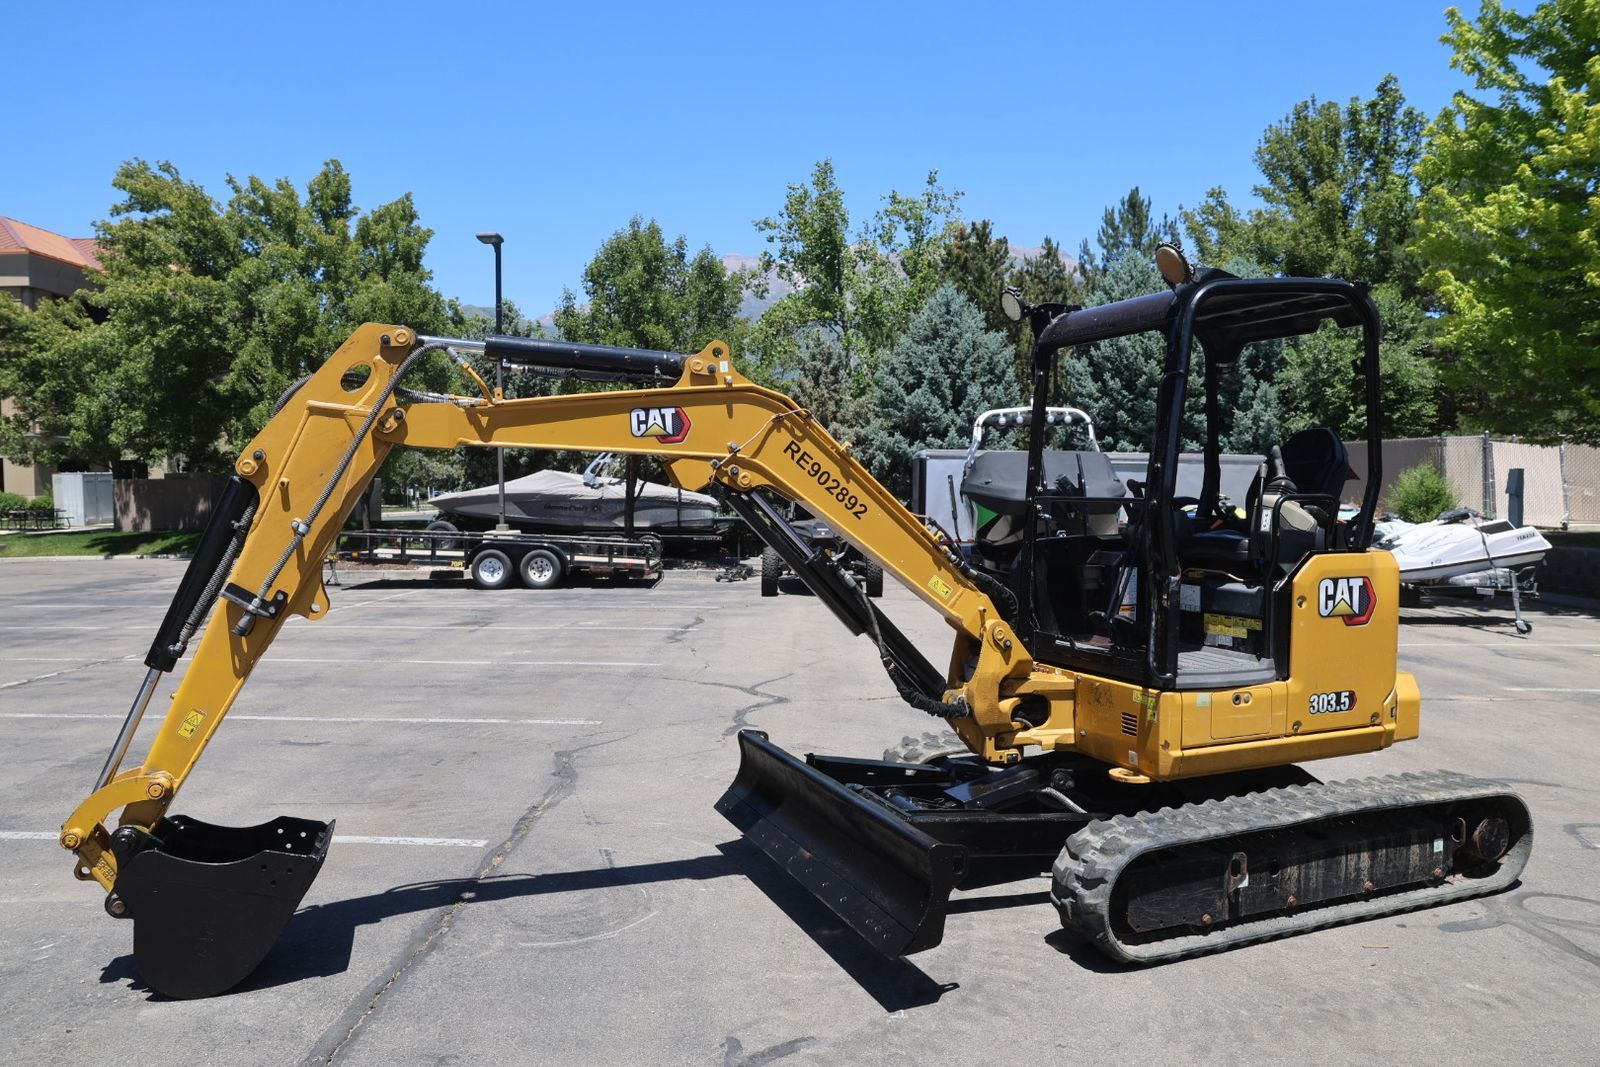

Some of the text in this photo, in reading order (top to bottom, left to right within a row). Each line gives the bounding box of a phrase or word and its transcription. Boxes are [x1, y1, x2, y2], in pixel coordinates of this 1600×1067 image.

[631, 408, 676, 437] CAT
[783, 440, 868, 520] RE902892
[1320, 578, 1363, 616] CAT
[1310, 691, 1350, 713] 303.5
